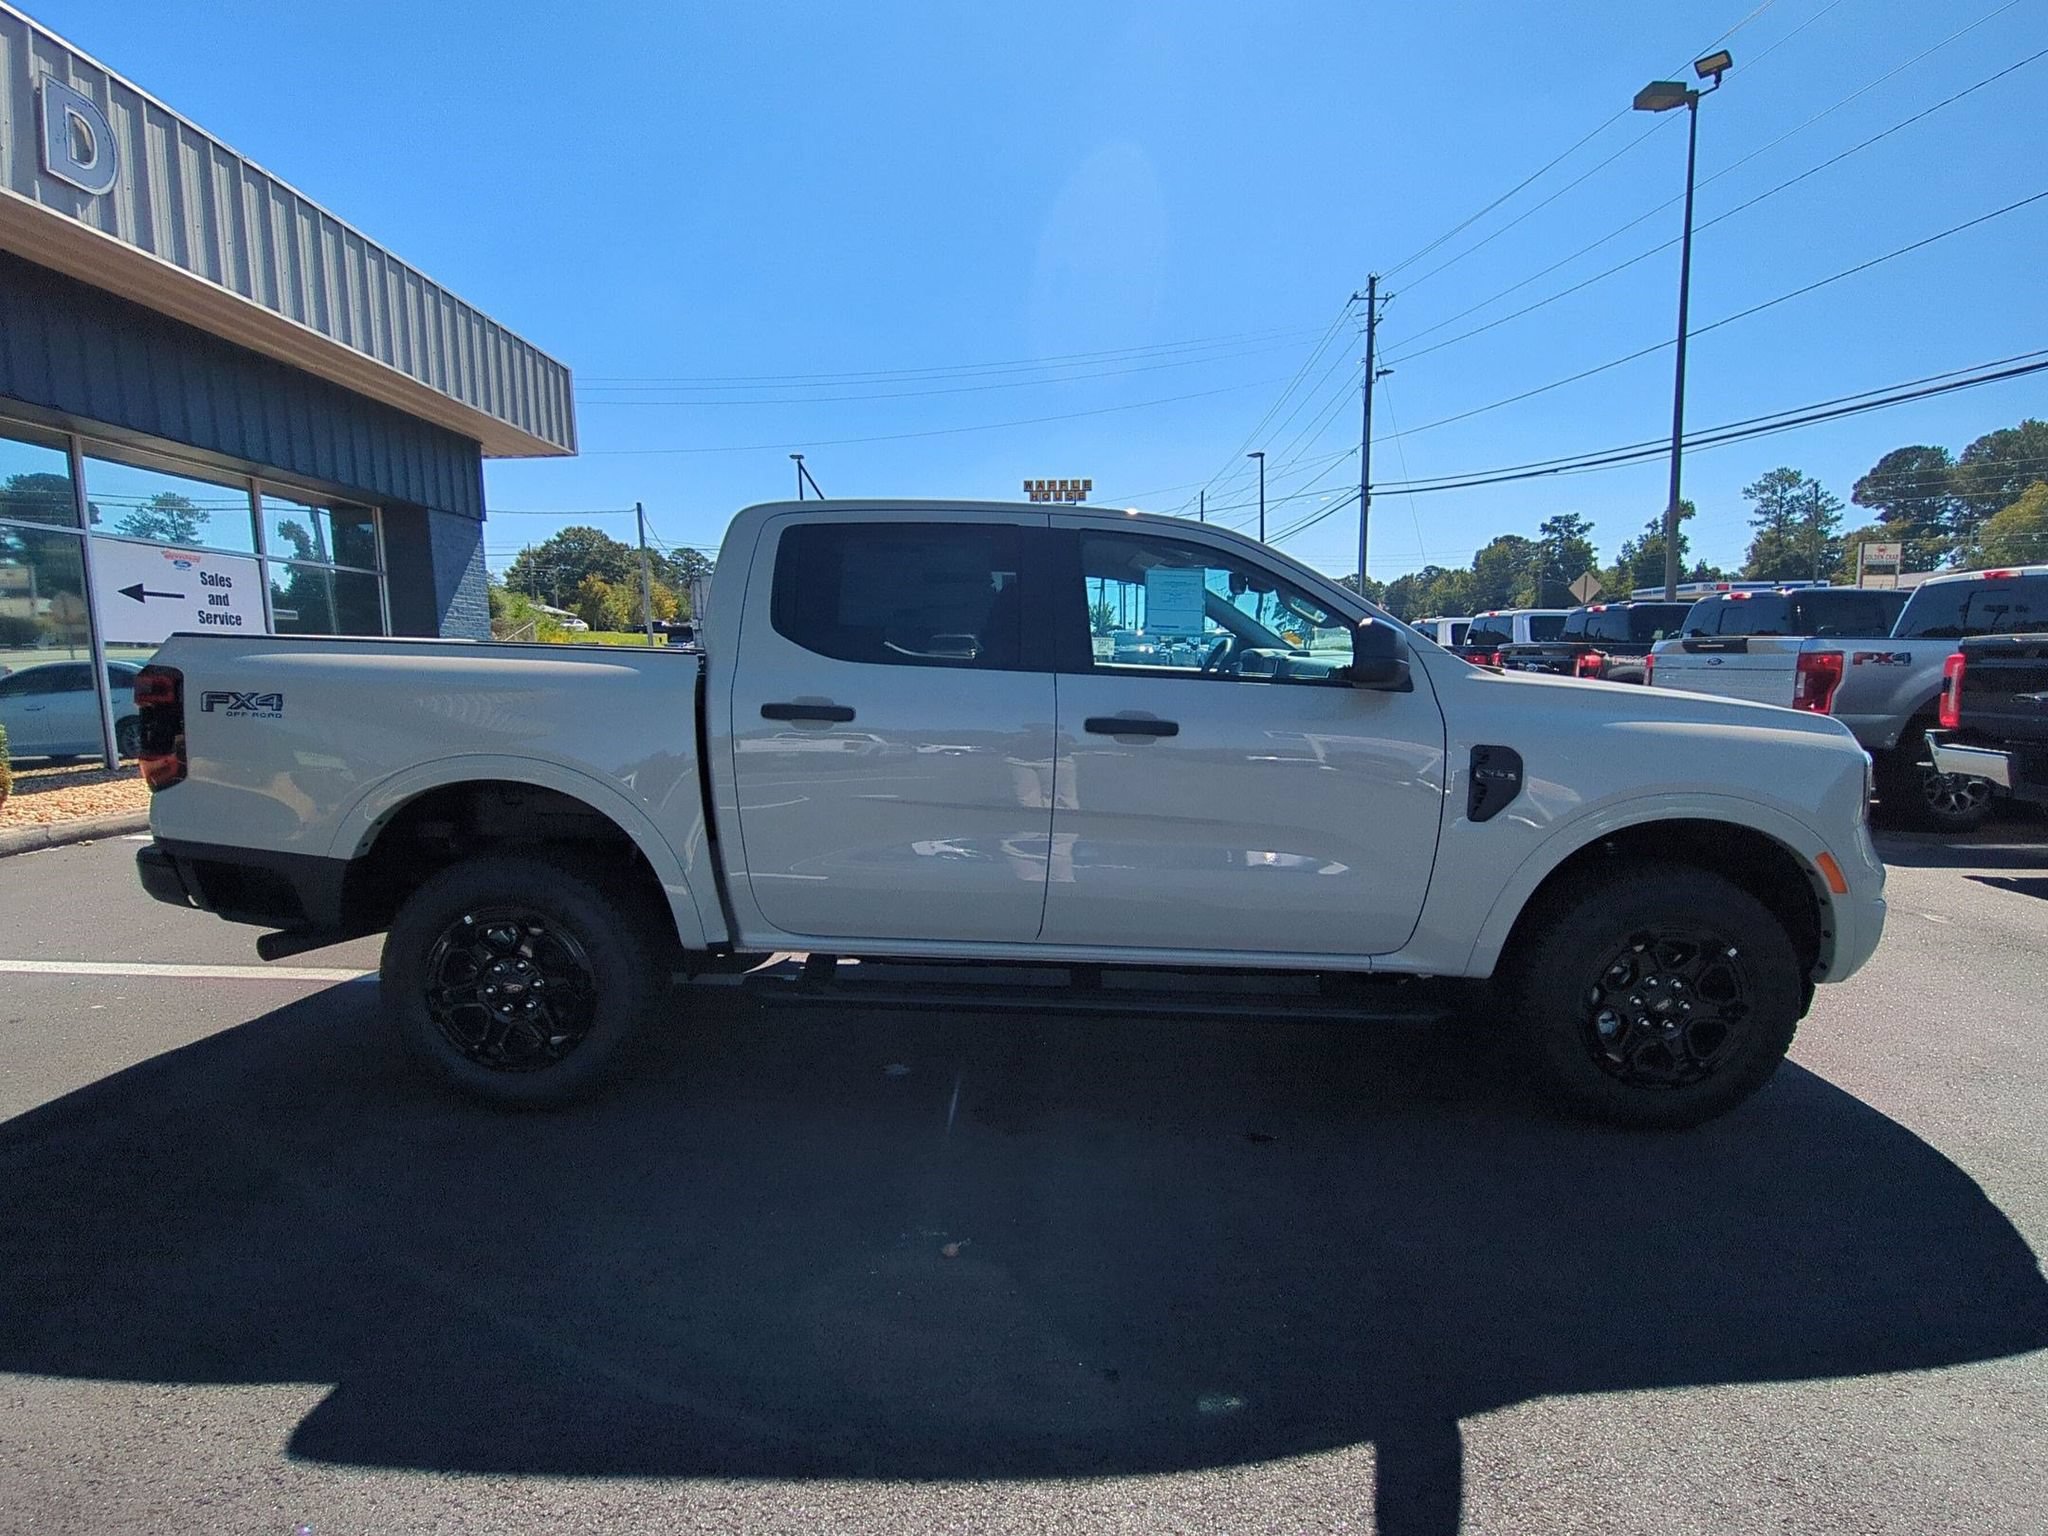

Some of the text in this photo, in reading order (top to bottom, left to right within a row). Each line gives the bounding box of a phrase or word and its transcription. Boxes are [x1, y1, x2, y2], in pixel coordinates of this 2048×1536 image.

[40, 70, 120, 195] D
[1024, 480, 1092, 491] WAFFLE
[1030, 491, 1086, 501] HOUSE
[200, 571, 232, 588] Sales
[208, 593, 230, 606] and
[198, 610, 242, 625] Service
[1852, 652, 1912, 666] FX4
[200, 691, 283, 712] FX4
